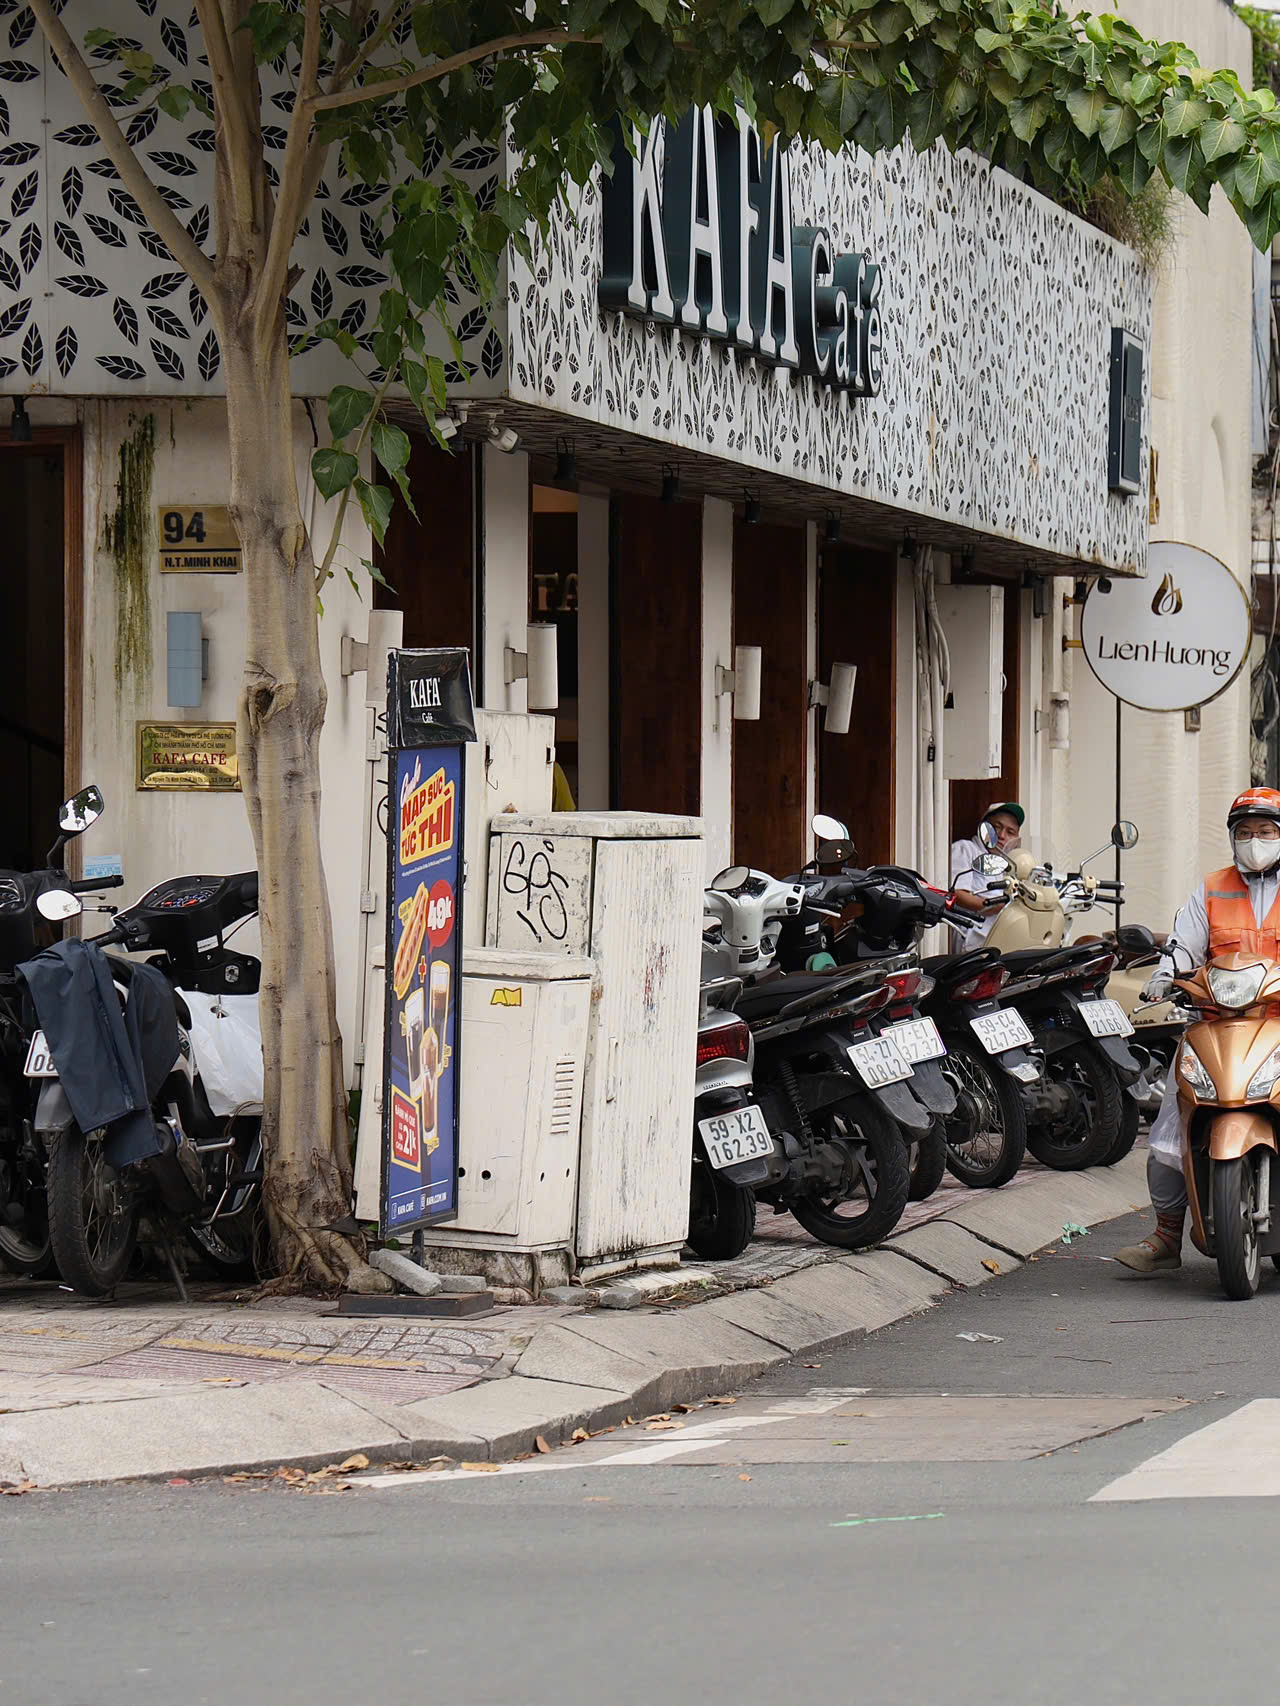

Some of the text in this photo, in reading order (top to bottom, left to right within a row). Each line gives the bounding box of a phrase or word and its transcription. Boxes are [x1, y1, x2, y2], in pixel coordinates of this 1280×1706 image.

[811, 228, 883, 397] Café
[163, 511, 206, 544] 94
[165, 556, 237, 568] N.T.MINH KHAI
[409, 677, 441, 708] KAFA
[152, 750, 227, 766] KAFA CAFÉ
[401, 774, 443, 832] NẠP SỨC
[427, 896, 453, 931] 49k
[978, 1012, 1015, 1035] 59-C4
[1092, 1018, 1122, 1034] 2166
[985, 1026, 1028, 1051] 247.59
[867, 1058, 906, 1083] 0842
[708, 1112, 756, 1141] 59-X2
[711, 1132, 768, 1164] 162.39
